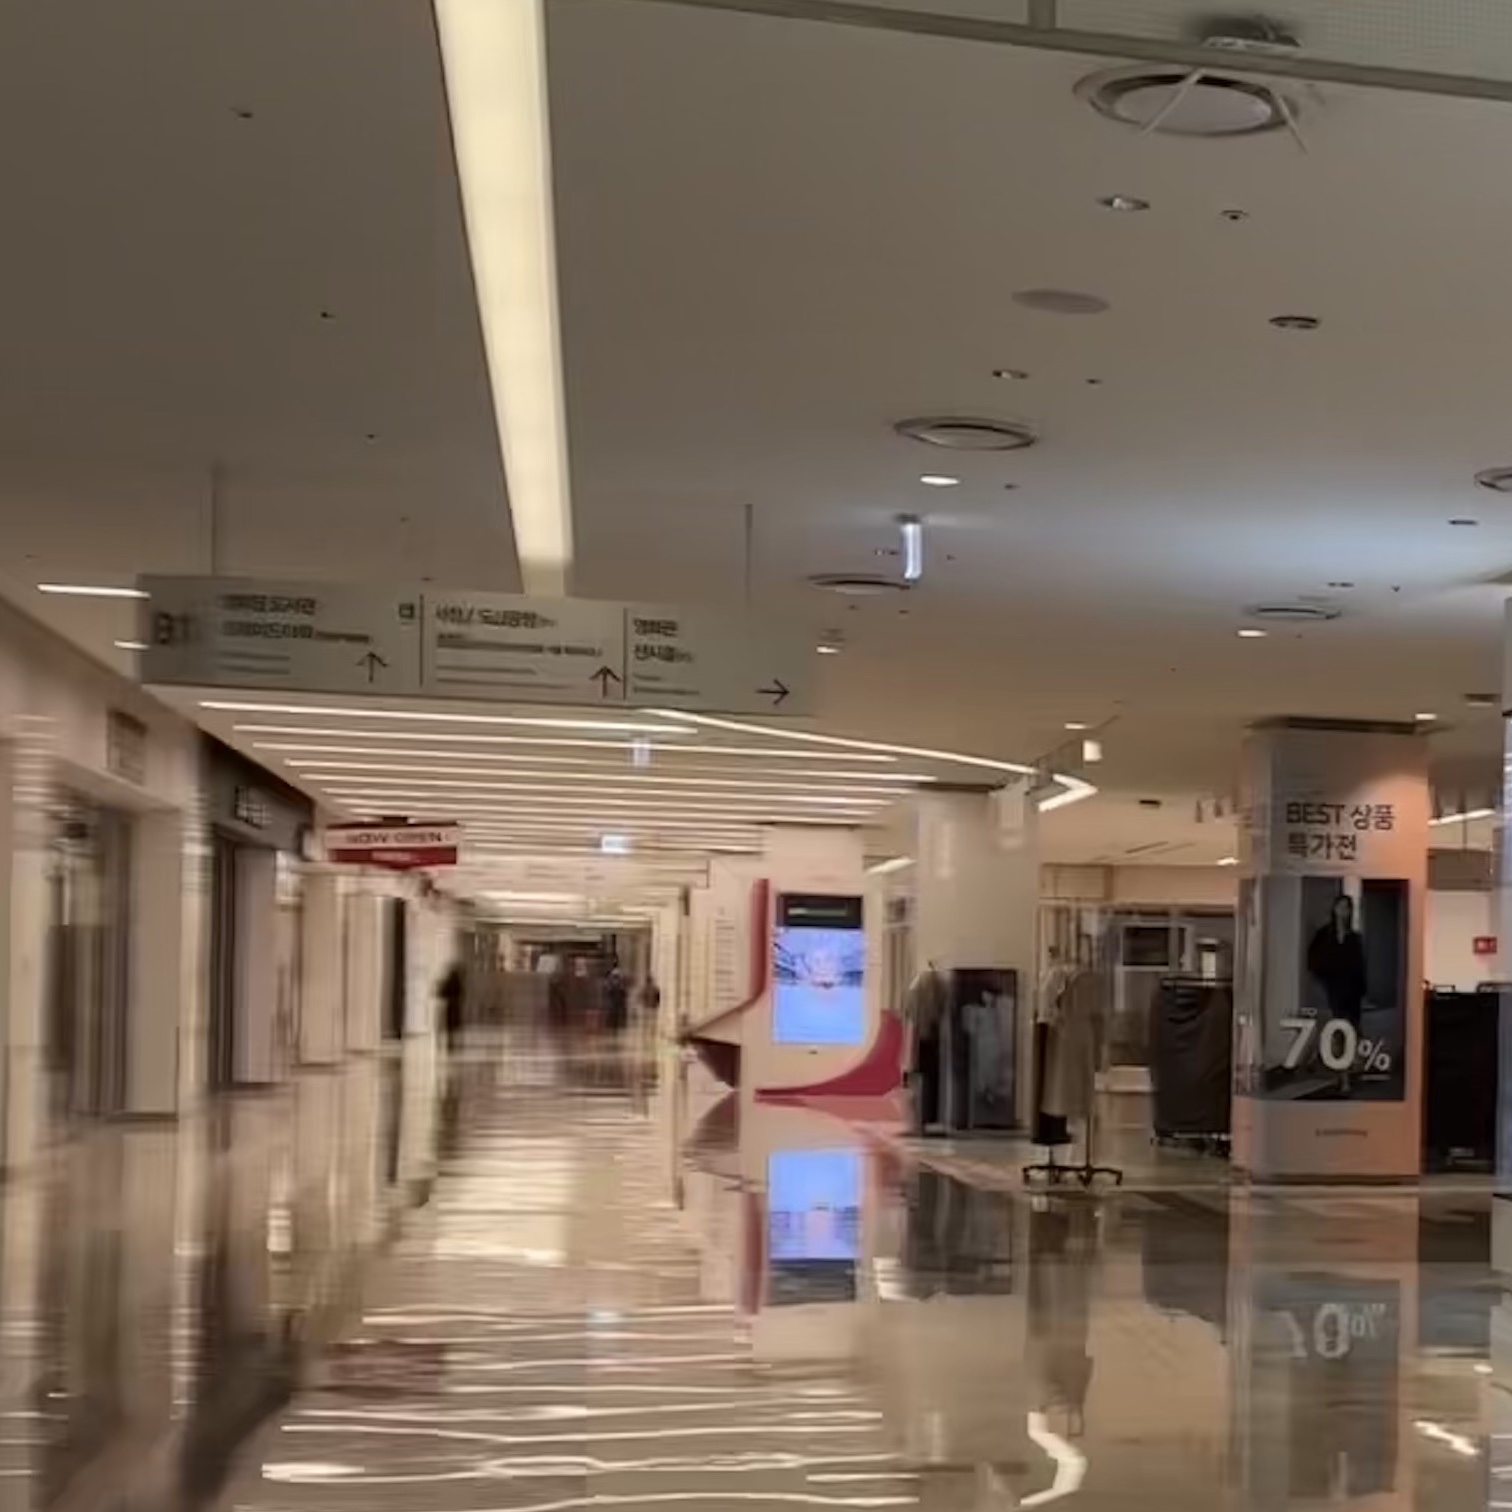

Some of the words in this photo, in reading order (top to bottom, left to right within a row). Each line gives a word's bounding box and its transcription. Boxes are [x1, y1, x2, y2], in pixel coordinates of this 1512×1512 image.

[1286, 803, 1345, 825] BEST
[1351, 804, 1396, 830] 상품
[1288, 832, 1357, 860] 특가전
[1280, 1018, 1391, 1071] 70%
